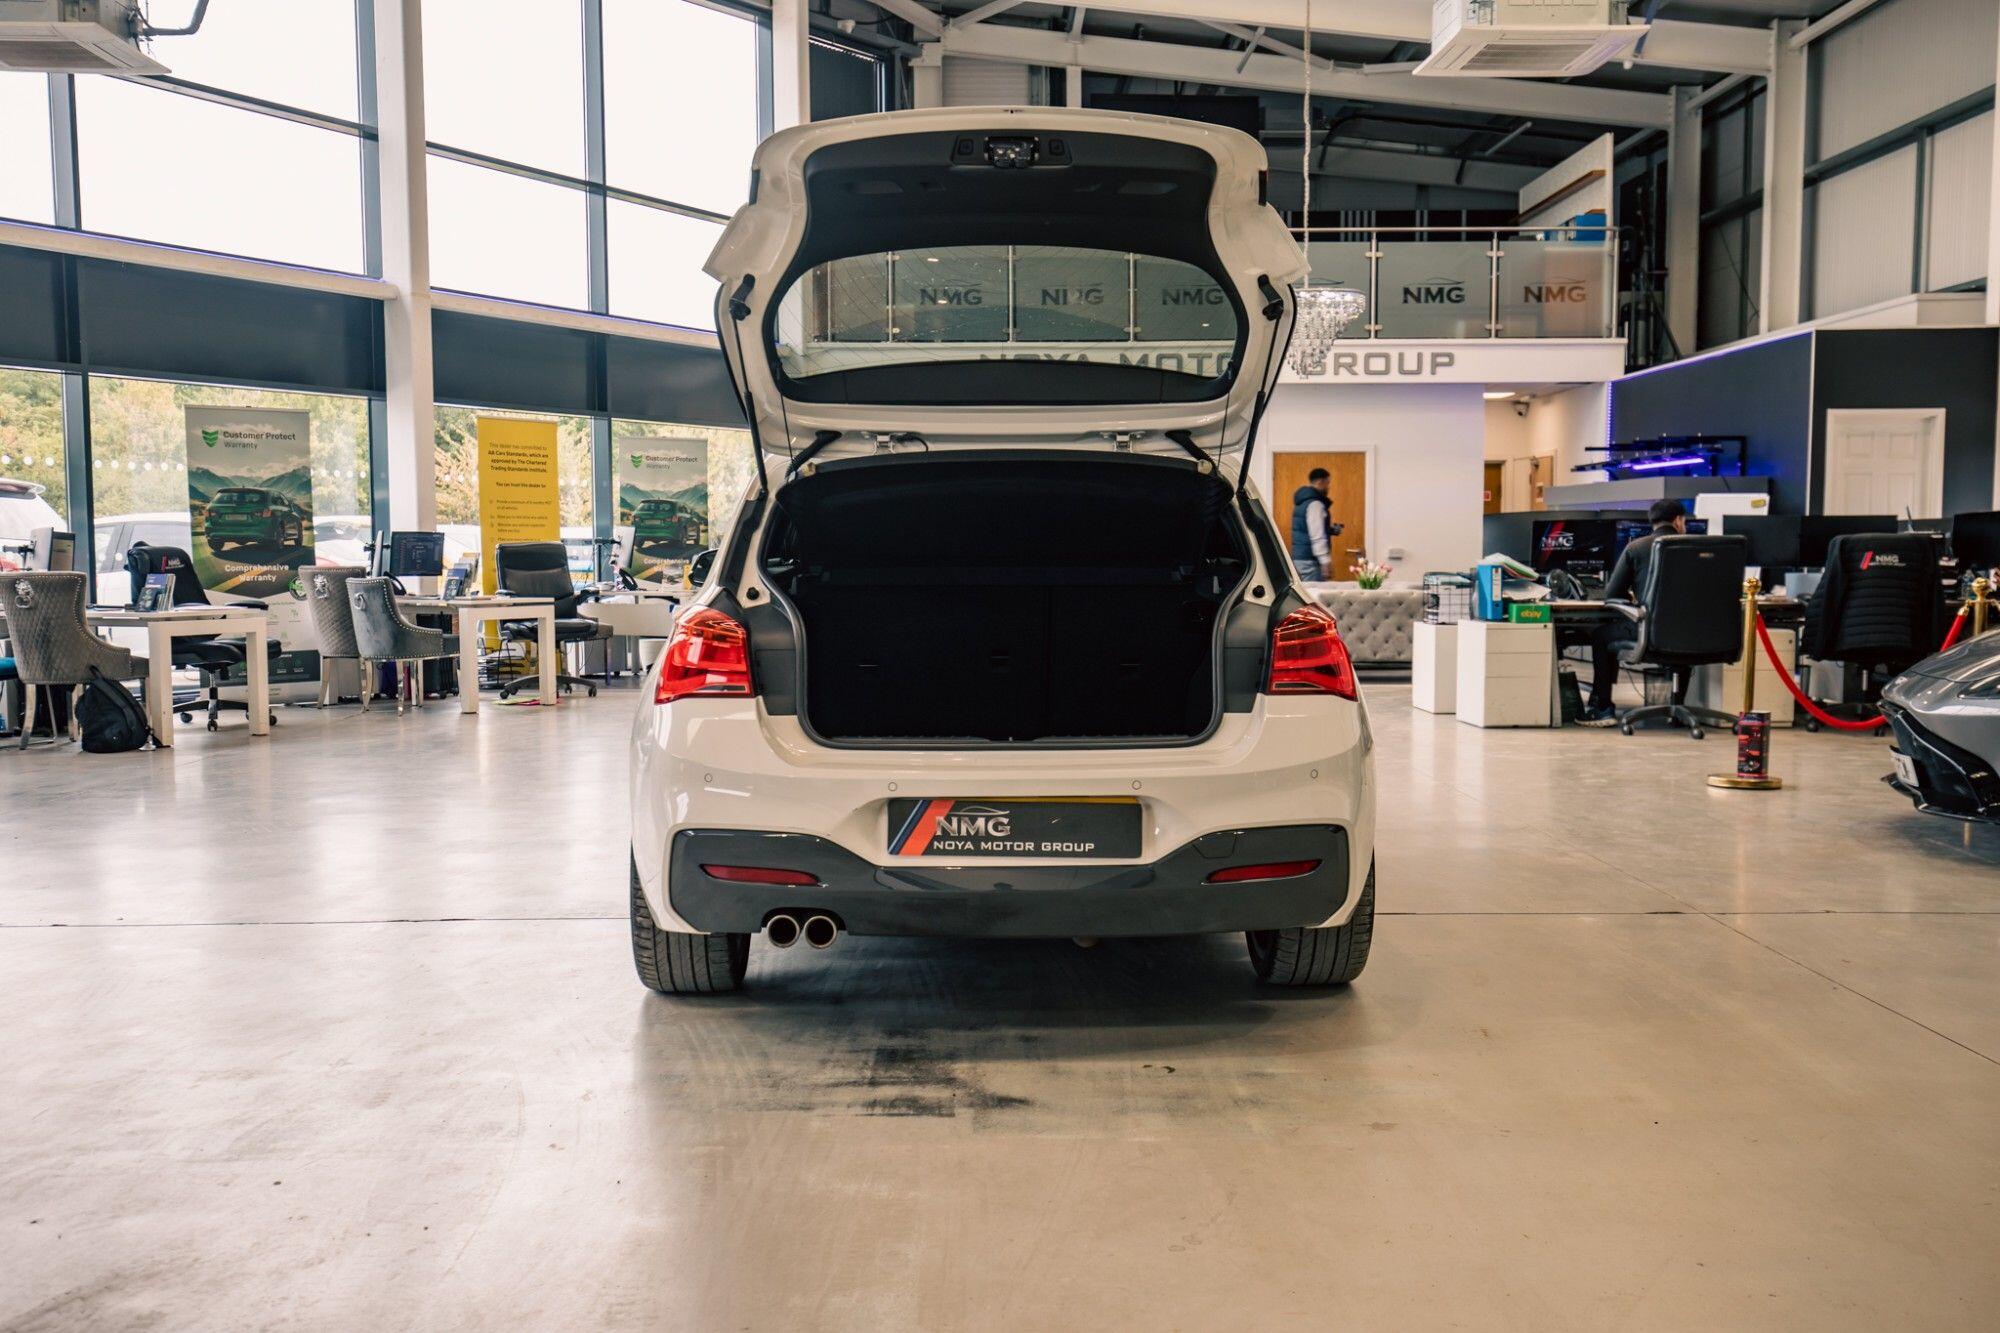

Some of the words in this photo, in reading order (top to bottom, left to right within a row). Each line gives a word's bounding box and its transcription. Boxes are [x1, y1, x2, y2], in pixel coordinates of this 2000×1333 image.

[920, 288, 982, 305] NMG
[1162, 288, 1224, 305] NMG
[1402, 286, 1466, 304] NMG
[1523, 285, 1587, 303] NMG
[223, 430, 264, 440] Customer
[265, 431, 296, 441] Protect
[223, 441, 258, 450] Warranty
[1875, 554, 1899, 563] NMG
[224, 563, 290, 573] Comprehensive
[239, 573, 277, 582] Warranty
[935, 815, 1011, 837] NMG
[933, 840, 974, 851] NOYA
[980, 841, 1035, 852] MOTOR
[1041, 842, 1096, 852] GROUP
